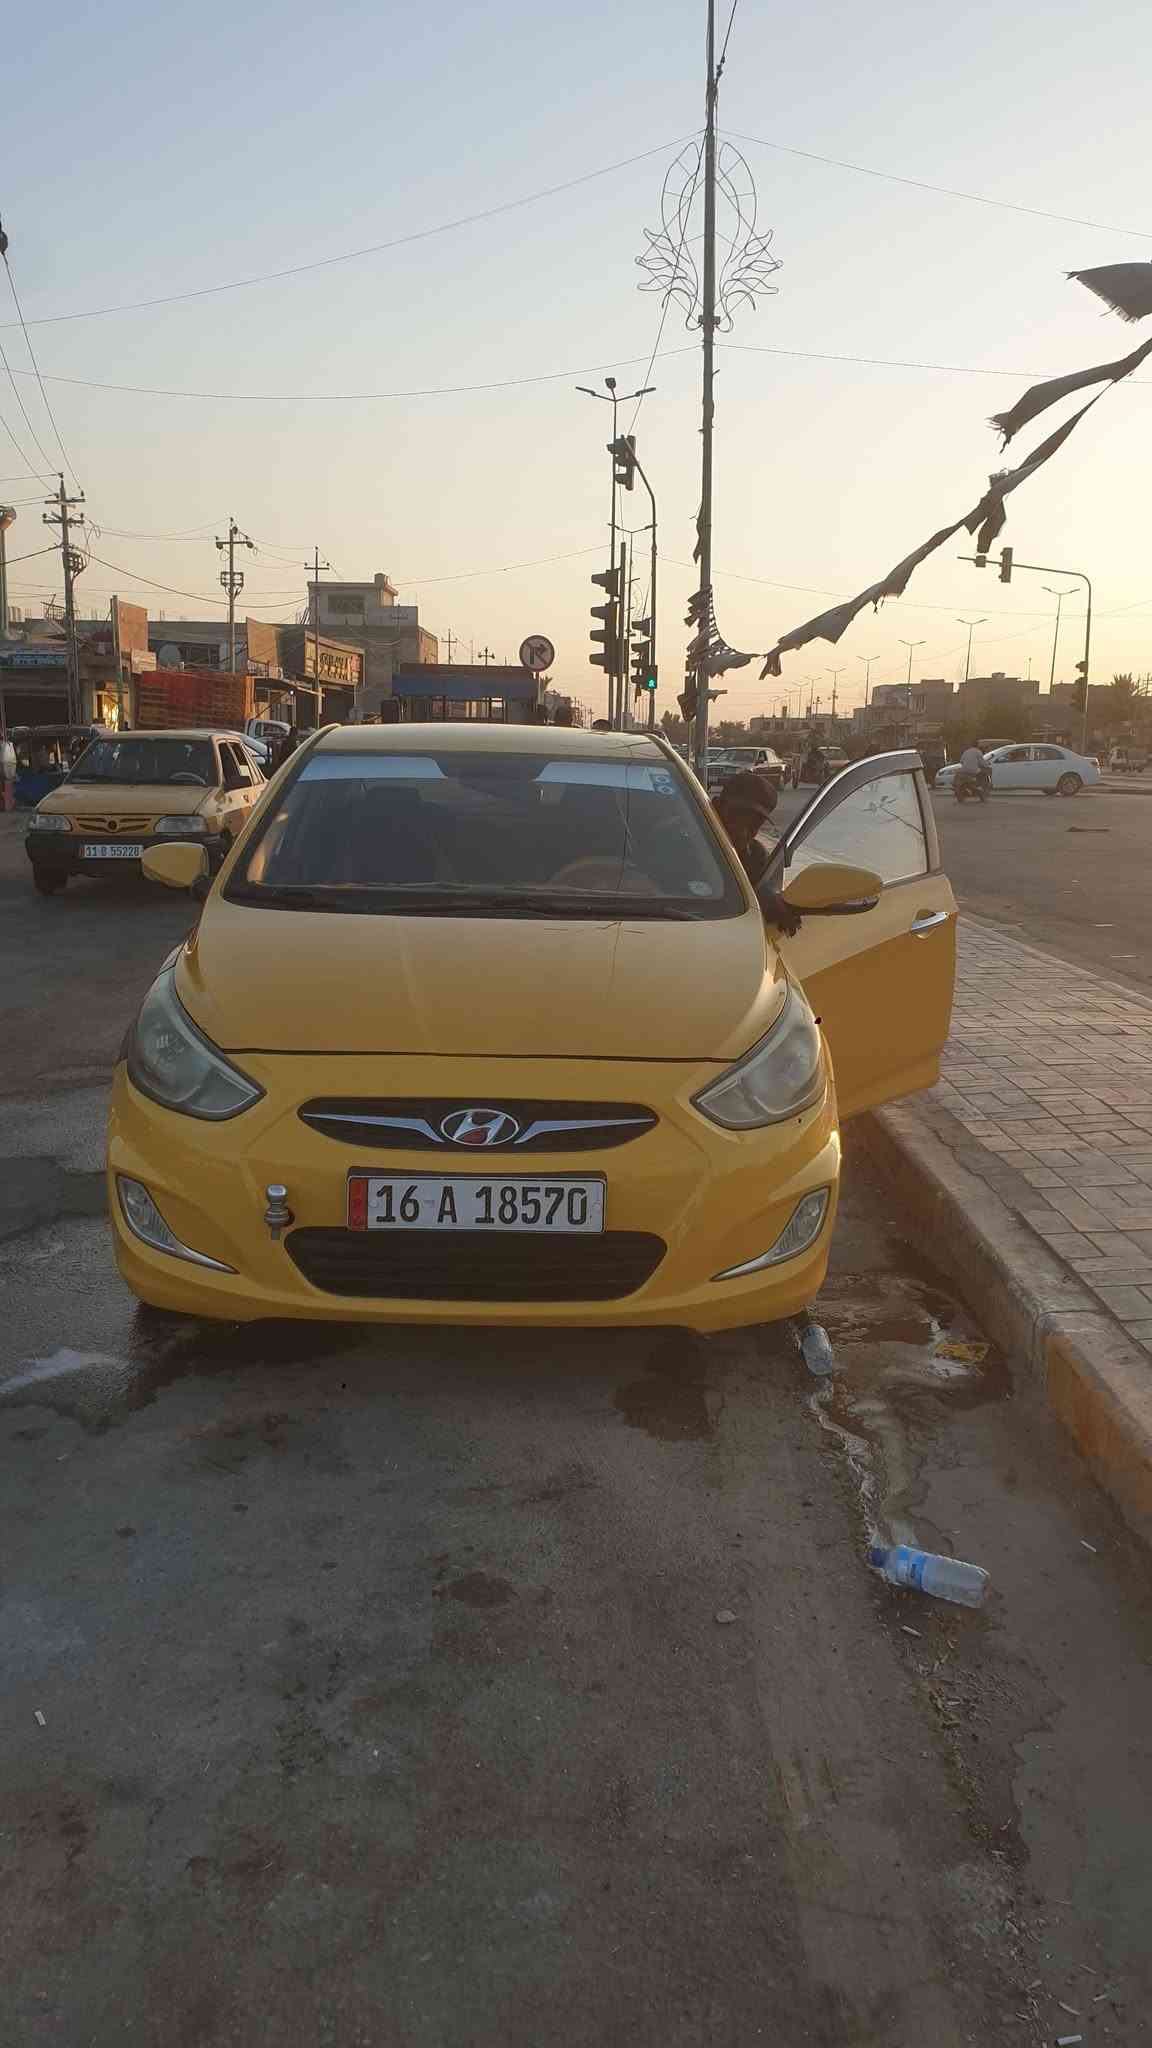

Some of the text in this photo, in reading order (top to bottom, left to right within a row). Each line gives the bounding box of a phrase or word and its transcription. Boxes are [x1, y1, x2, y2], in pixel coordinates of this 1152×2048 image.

[86, 846, 97, 857] 11
[375, 1184, 588, 1225] 16 A 18570
